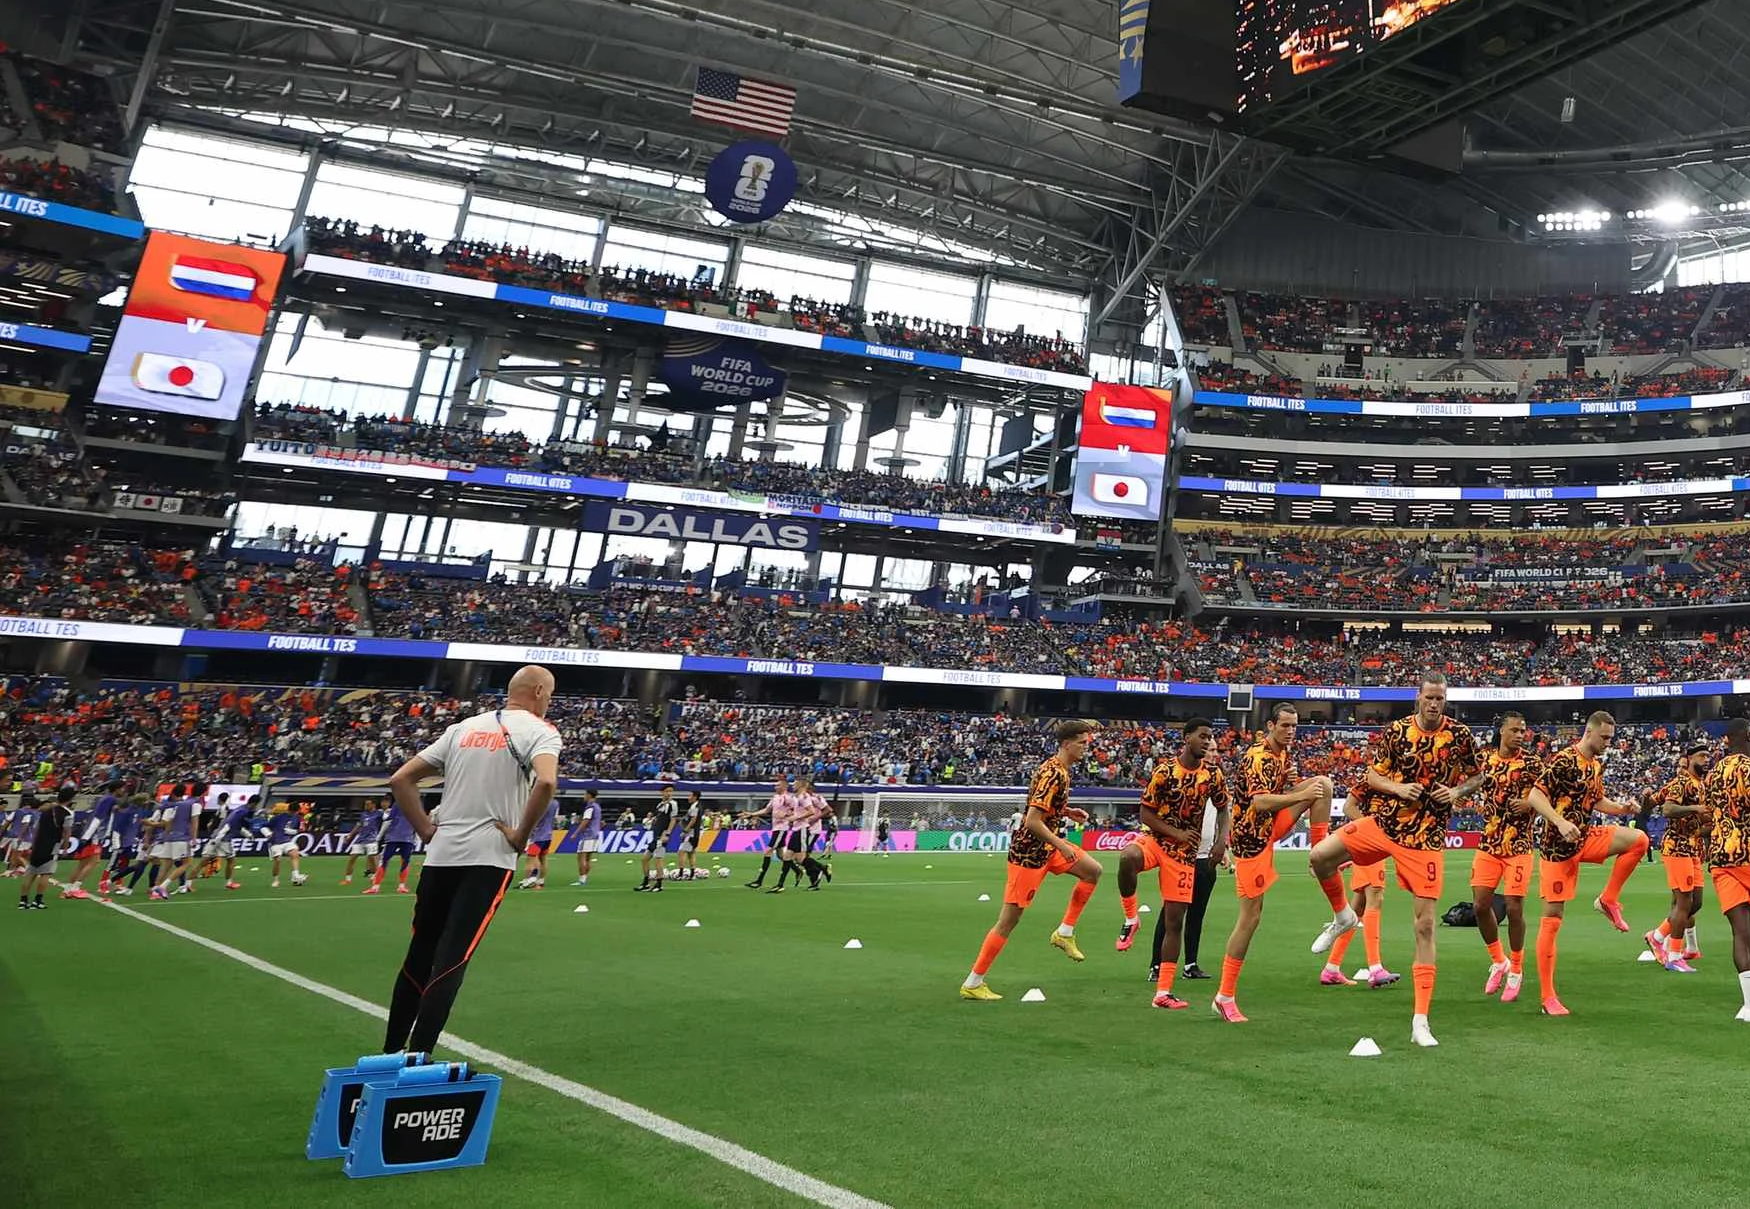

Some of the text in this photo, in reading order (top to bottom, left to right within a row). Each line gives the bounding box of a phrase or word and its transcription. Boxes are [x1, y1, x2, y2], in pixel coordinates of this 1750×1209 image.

[368, 267, 410, 282] FOOTBALL
[551, 295, 591, 311] FOOTBALL
[716, 321, 752, 335] FOOTBALL
[866, 345, 899, 359] FOOTBALL
[720, 357, 752, 372] FIFA
[691, 364, 774, 388] WORLD CUP
[1004, 366, 1034, 379] FOOTBALL
[700, 381, 753, 396] 2026
[1247, 396, 1286, 408] FOOTBALL
[1416, 405, 1454, 414] FOOTBALL
[1581, 402, 1619, 413] FOOTBALL
[607, 508, 809, 548] DALLAS
[1494, 569, 1515, 577] FIFA
[1516, 569, 1551, 577] WORLD
[56, 623, 79, 636] TES
[268, 635, 357, 652] FOOTBALL TES
[525, 649, 599, 664] FOOTBALL TES
[747, 661, 814, 675] FOOTBALL TES
[943, 672, 1000, 684] FOOTBALL TES
[1117, 681, 1169, 694] FOOTBALL TES
[1306, 688, 1360, 699] FOOTBALL TES
[1473, 690, 1526, 700] FOOTBALL TES
[1634, 685, 1682, 696] FOOTBALL TES
[291, 833, 361, 856] QAT
[597, 831, 654, 853] VISA
[949, 831, 1011, 851] aram
[1427, 862, 1436, 880] 9
[1514, 865, 1523, 882] 5
[394, 1108, 465, 1129] POWER
[422, 1124, 462, 1141] ADE
